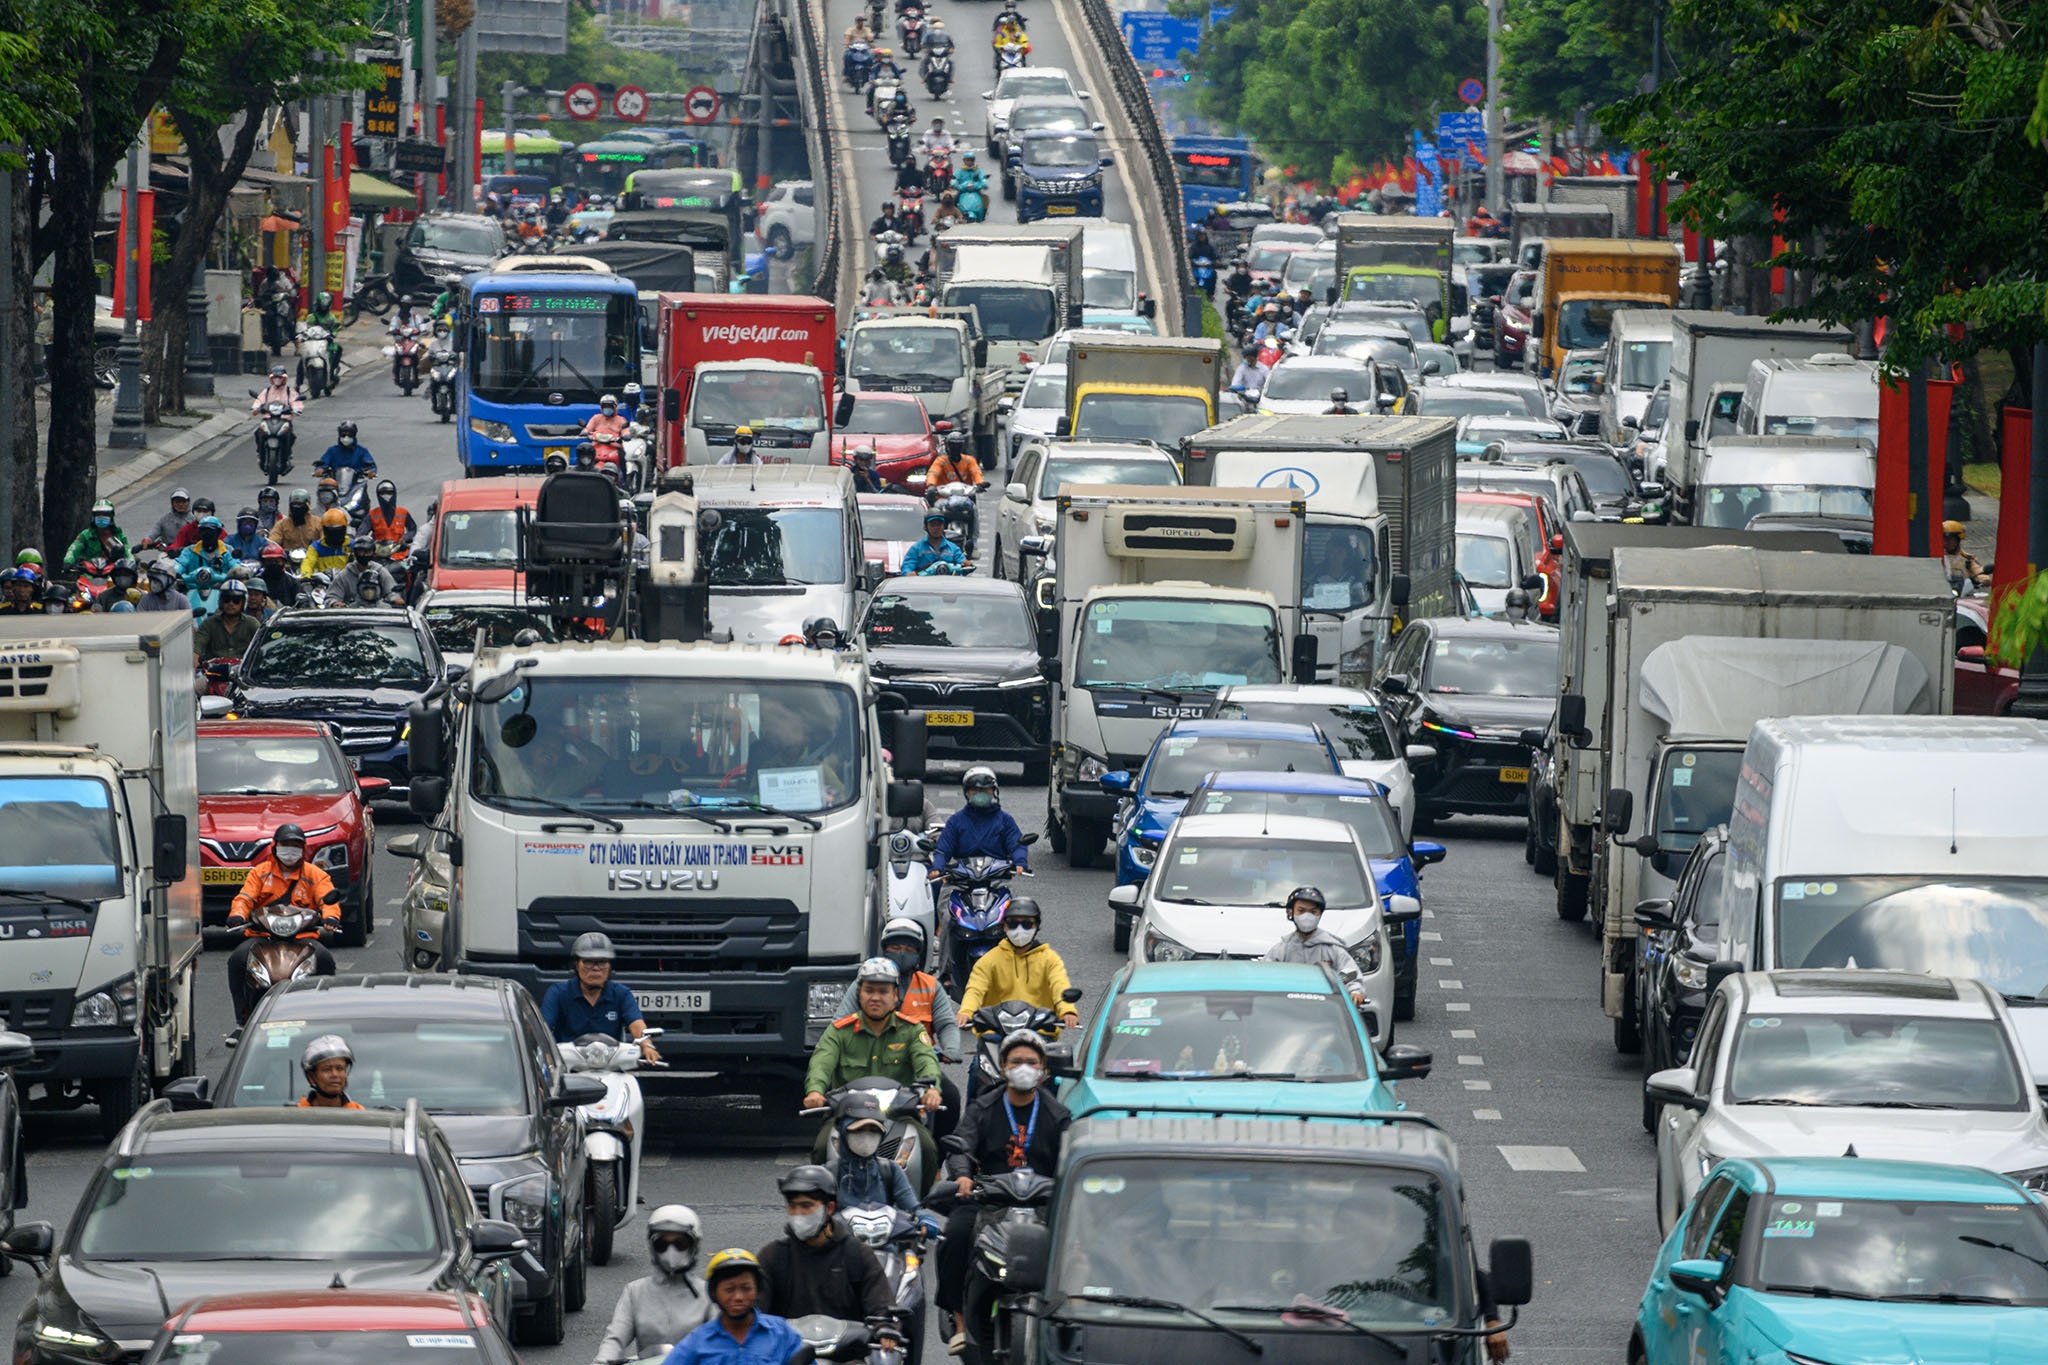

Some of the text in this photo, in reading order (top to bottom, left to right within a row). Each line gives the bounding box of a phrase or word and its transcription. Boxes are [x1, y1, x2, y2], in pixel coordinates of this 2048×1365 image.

[0, 654, 41, 664] ASTER
[1152, 706, 1203, 718] ISUZU
[926, 713, 969, 724] E-586.75
[589, 840, 748, 865] CTY CÔNG VIÊN CÂY XANH TP.HCM
[751, 845, 803, 854] FVR
[751, 855, 804, 865] 900
[608, 869, 719, 891] ISUZU
[1775, 1220, 1815, 1230] TAXI
